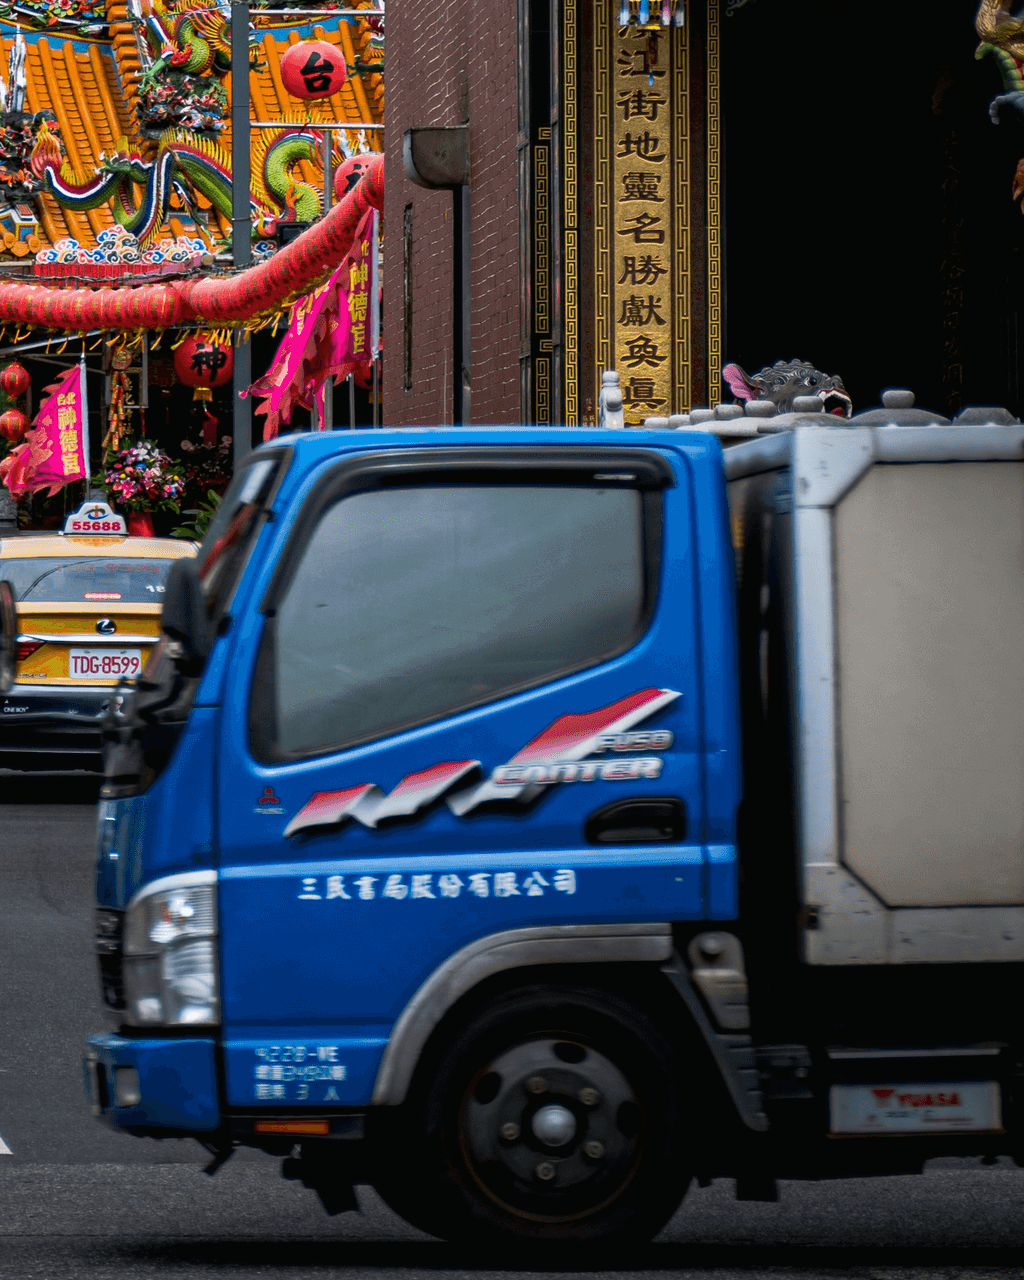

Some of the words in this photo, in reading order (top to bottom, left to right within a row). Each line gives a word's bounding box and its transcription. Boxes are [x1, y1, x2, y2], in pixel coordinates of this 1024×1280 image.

[300, 51, 335, 93] 台
[190, 342, 227, 382] 神
[72, 521, 122, 532] 55688
[71, 655, 140, 675] TDG-8599
[297, 869, 576, 901] 三民書局股份有限公司
